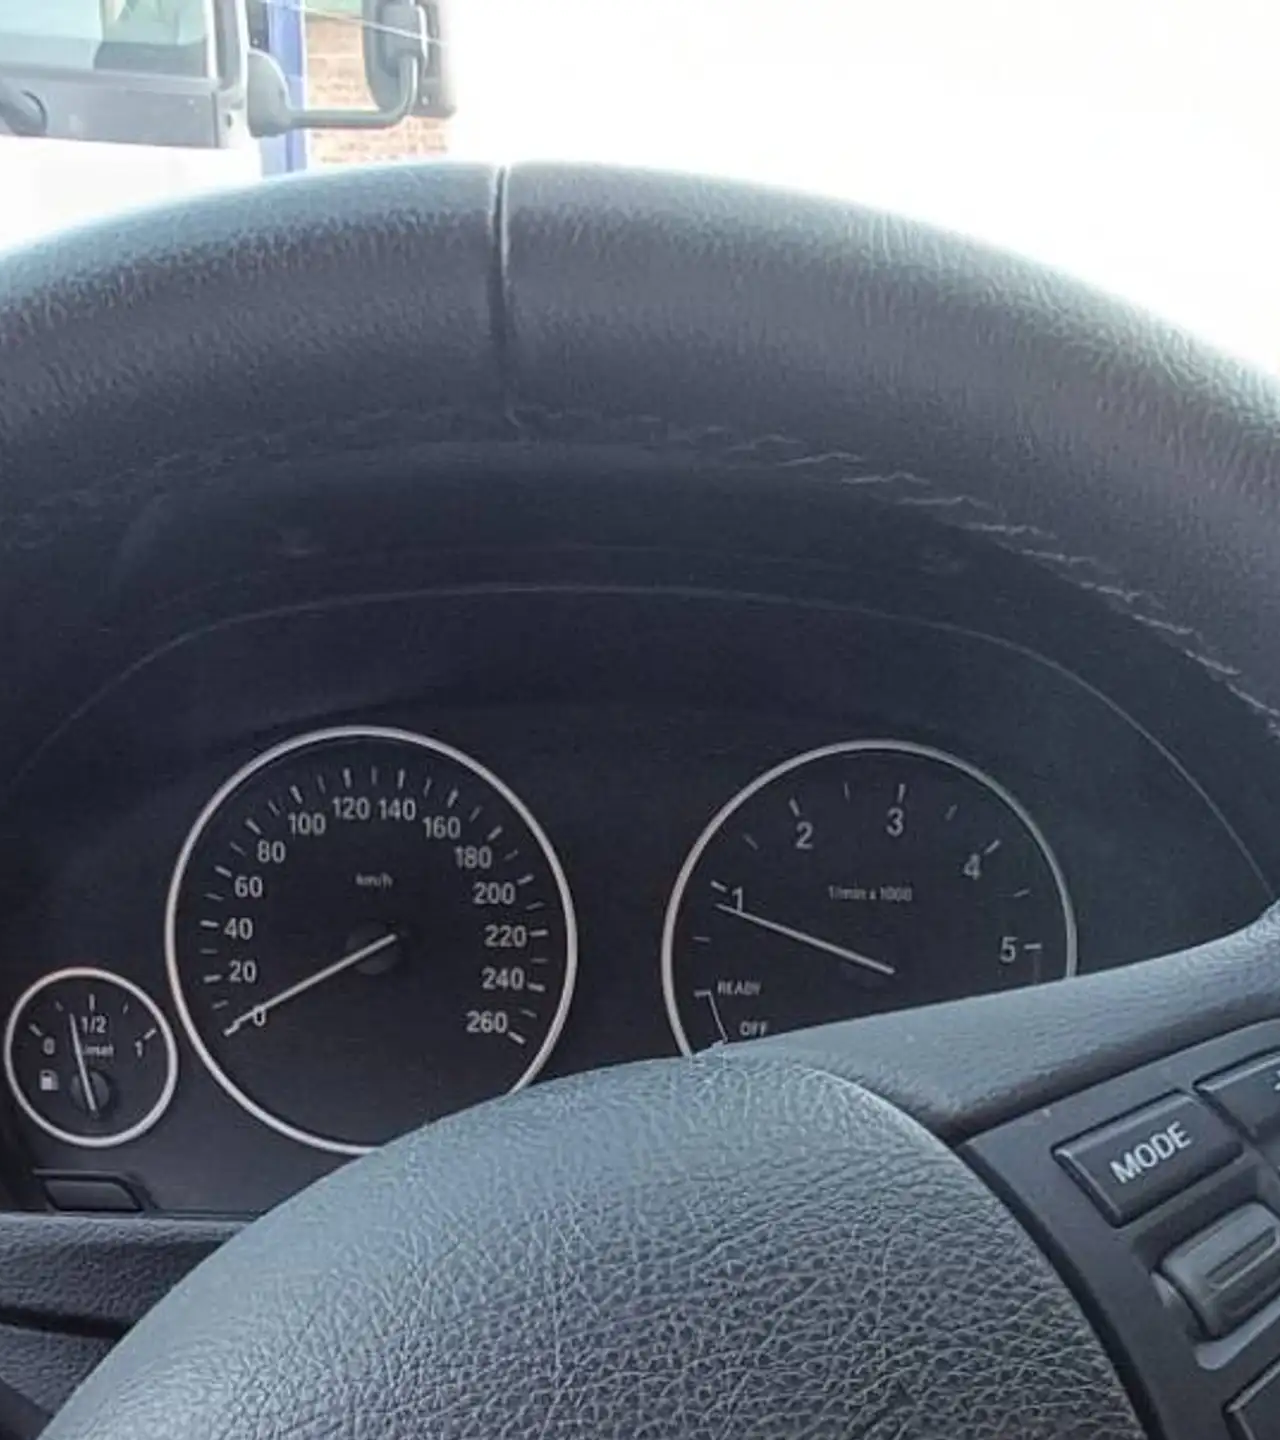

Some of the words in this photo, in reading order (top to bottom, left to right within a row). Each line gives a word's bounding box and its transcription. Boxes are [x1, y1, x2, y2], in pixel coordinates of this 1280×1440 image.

[332, 796, 370, 820] 120
[379, 798, 416, 821] 140
[288, 812, 326, 835] 100
[422, 816, 461, 839] 160
[887, 808, 904, 836] 3
[796, 821, 813, 849] 2
[257, 840, 286, 863] 80
[455, 846, 492, 869] 180
[963, 853, 981, 880] 4
[234, 875, 263, 898] 60
[473, 881, 515, 905] 200
[730, 887, 743, 913] 1
[224, 917, 253, 940] 40
[485, 924, 527, 948] 220
[1000, 936, 1017, 962] 5
[229, 960, 257, 983] 20
[482, 967, 524, 990] 240
[81, 1015, 107, 1034] 1/2
[250, 1007, 267, 1027] 0
[466, 1010, 508, 1034] 260
[43, 1037, 55, 1055] 0
[134, 1041, 143, 1057] 1
[1110, 1119, 1191, 1183] MODE
